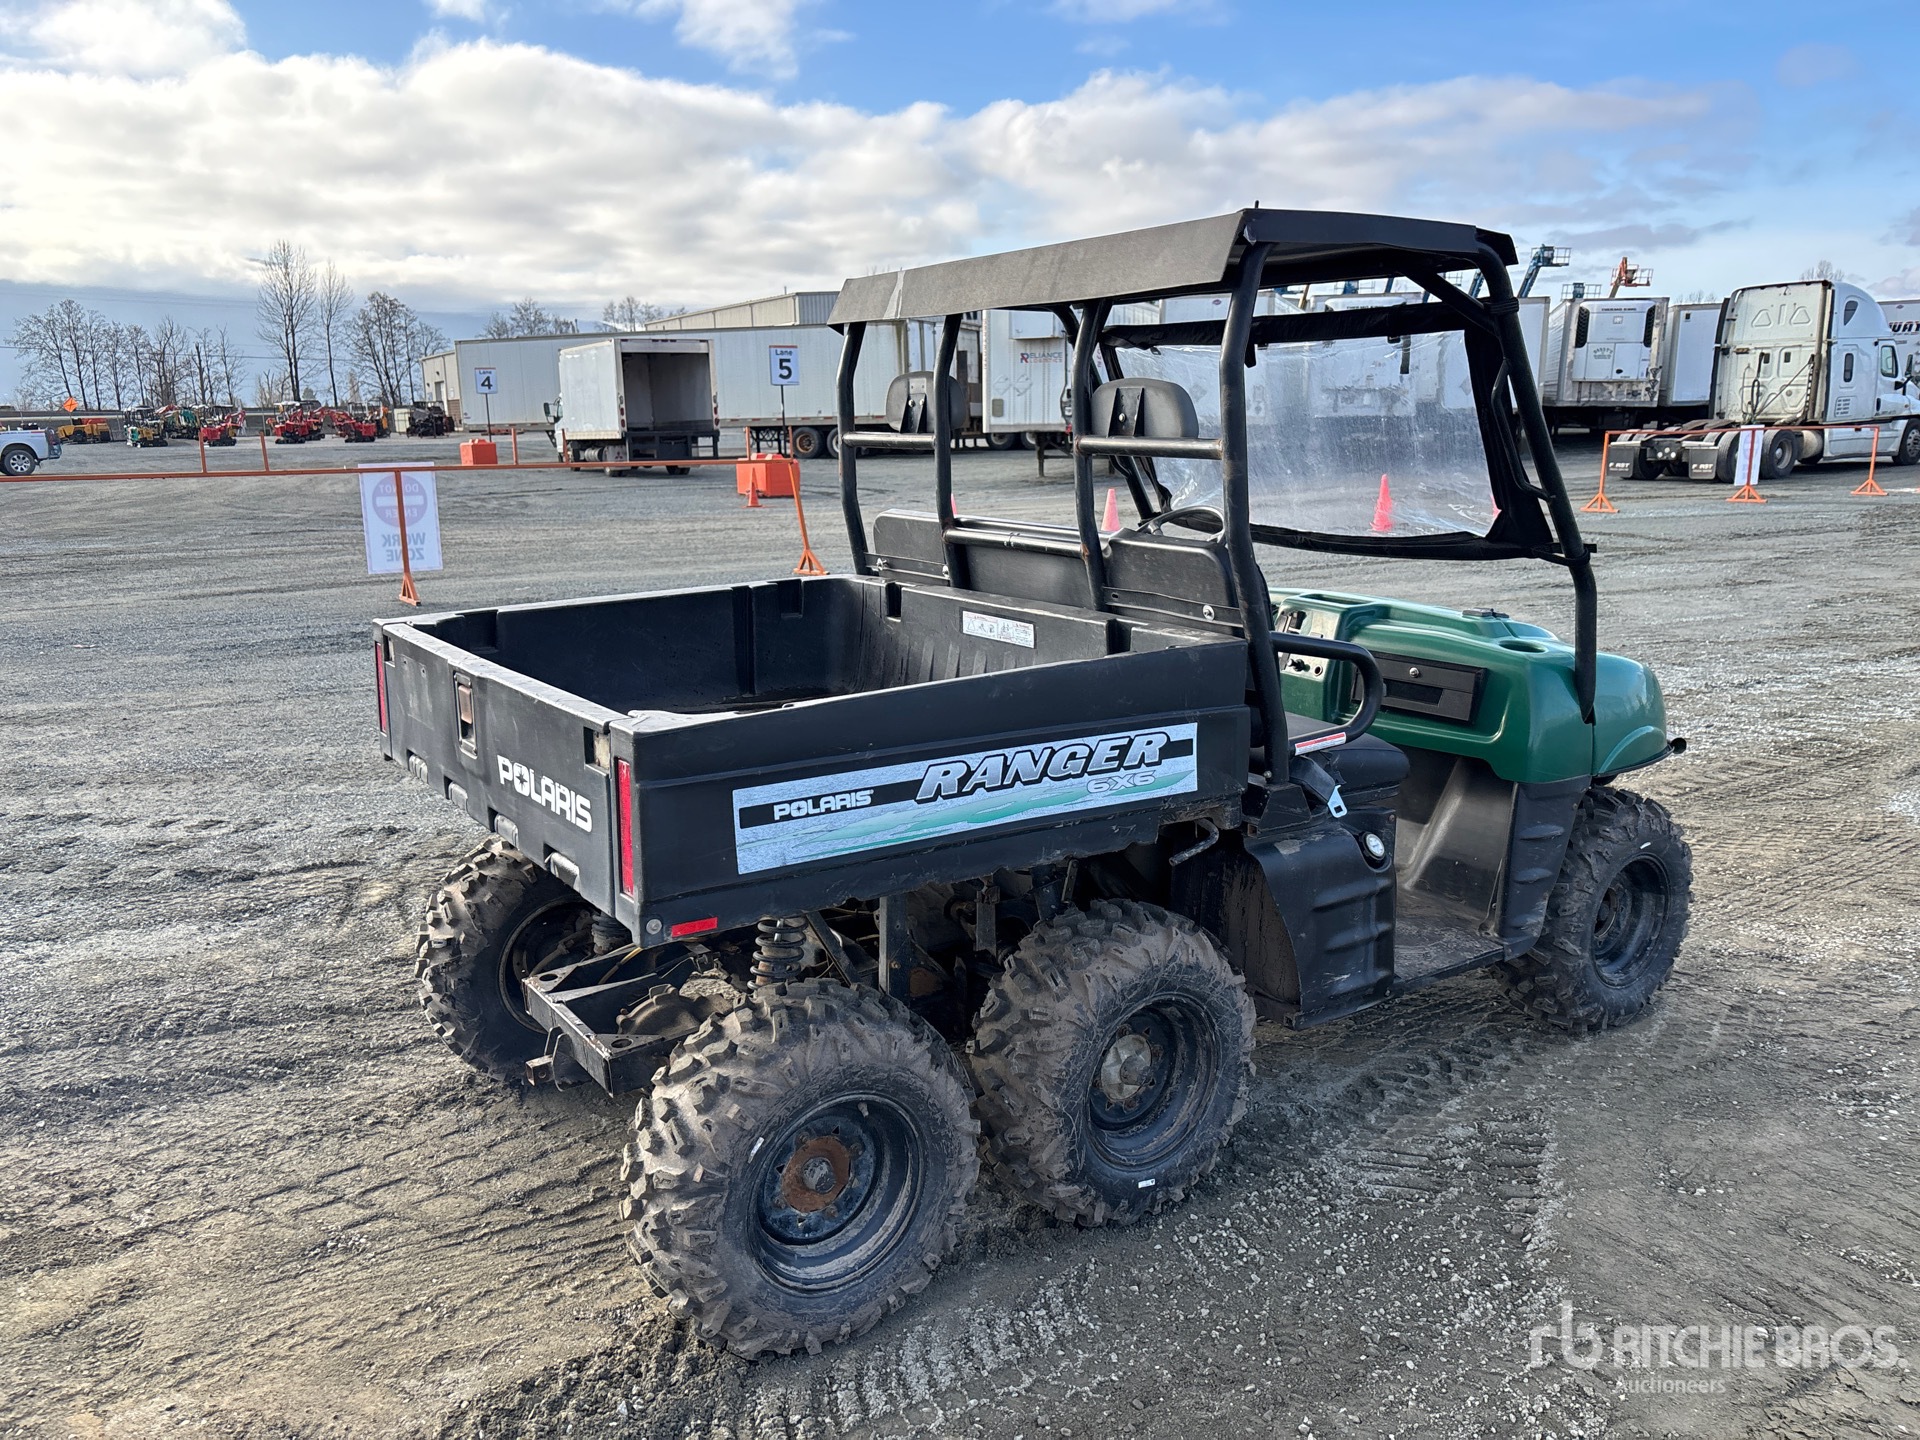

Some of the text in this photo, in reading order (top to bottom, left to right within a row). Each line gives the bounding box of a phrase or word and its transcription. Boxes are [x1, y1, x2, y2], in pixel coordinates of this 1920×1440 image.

[778, 358, 793, 380] 5
[1020, 352, 1063, 363] RELIANCE
[480, 375, 493, 390] 4
[915, 730, 1171, 805] RANGER
[496, 754, 593, 833] POLARIS
[1085, 769, 1158, 796] 6X6
[773, 788, 874, 822] POLARIS
